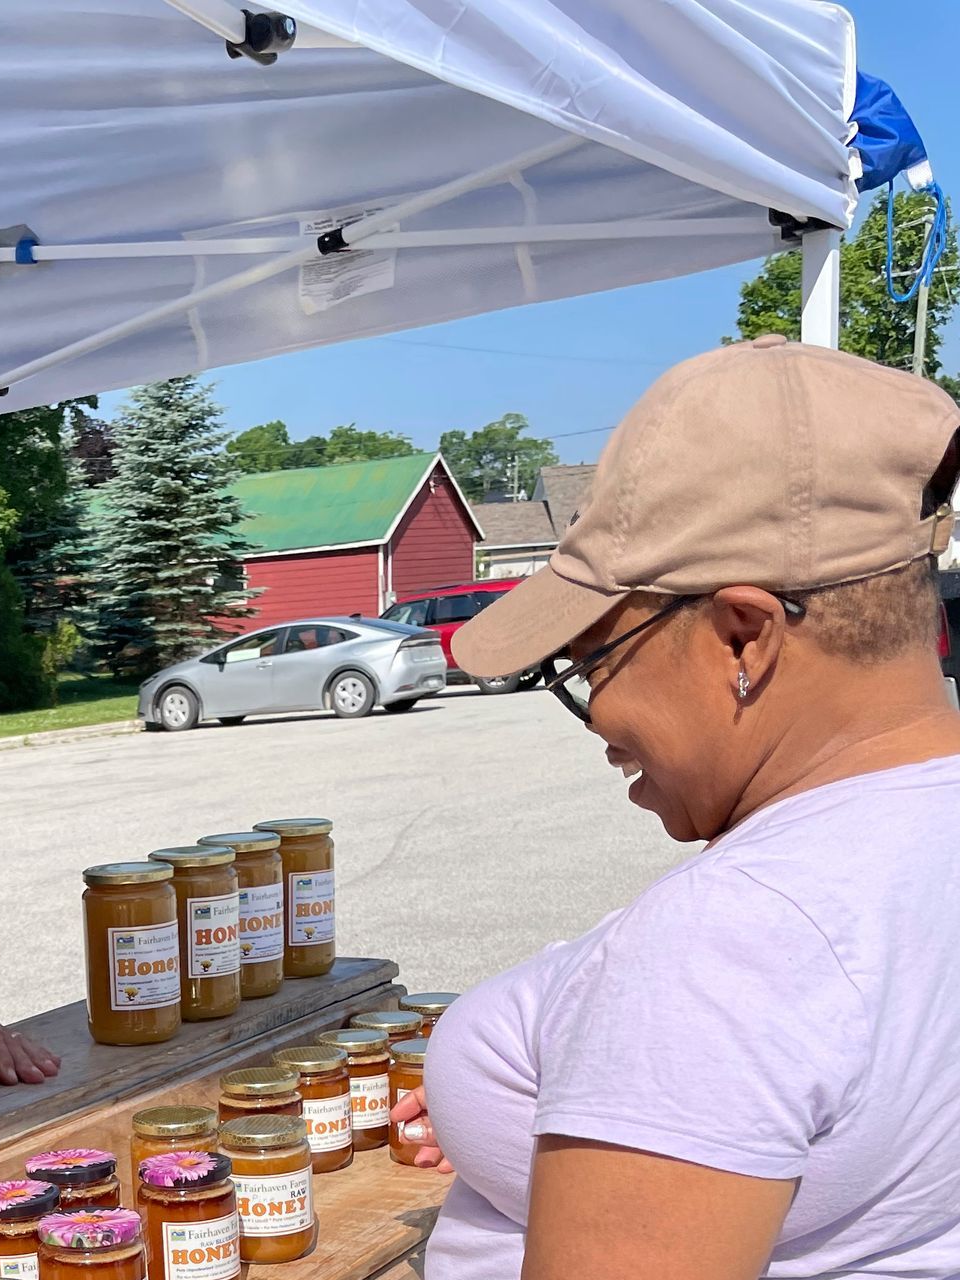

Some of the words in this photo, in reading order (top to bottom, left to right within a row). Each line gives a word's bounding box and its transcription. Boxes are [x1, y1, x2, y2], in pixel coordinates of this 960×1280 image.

[243, 1184, 287, 1193] Fairhaven
[237, 1195, 307, 1217] HONEY
[188, 1226, 230, 1240] Fairhaven
[171, 1237, 238, 1265] HONEY
